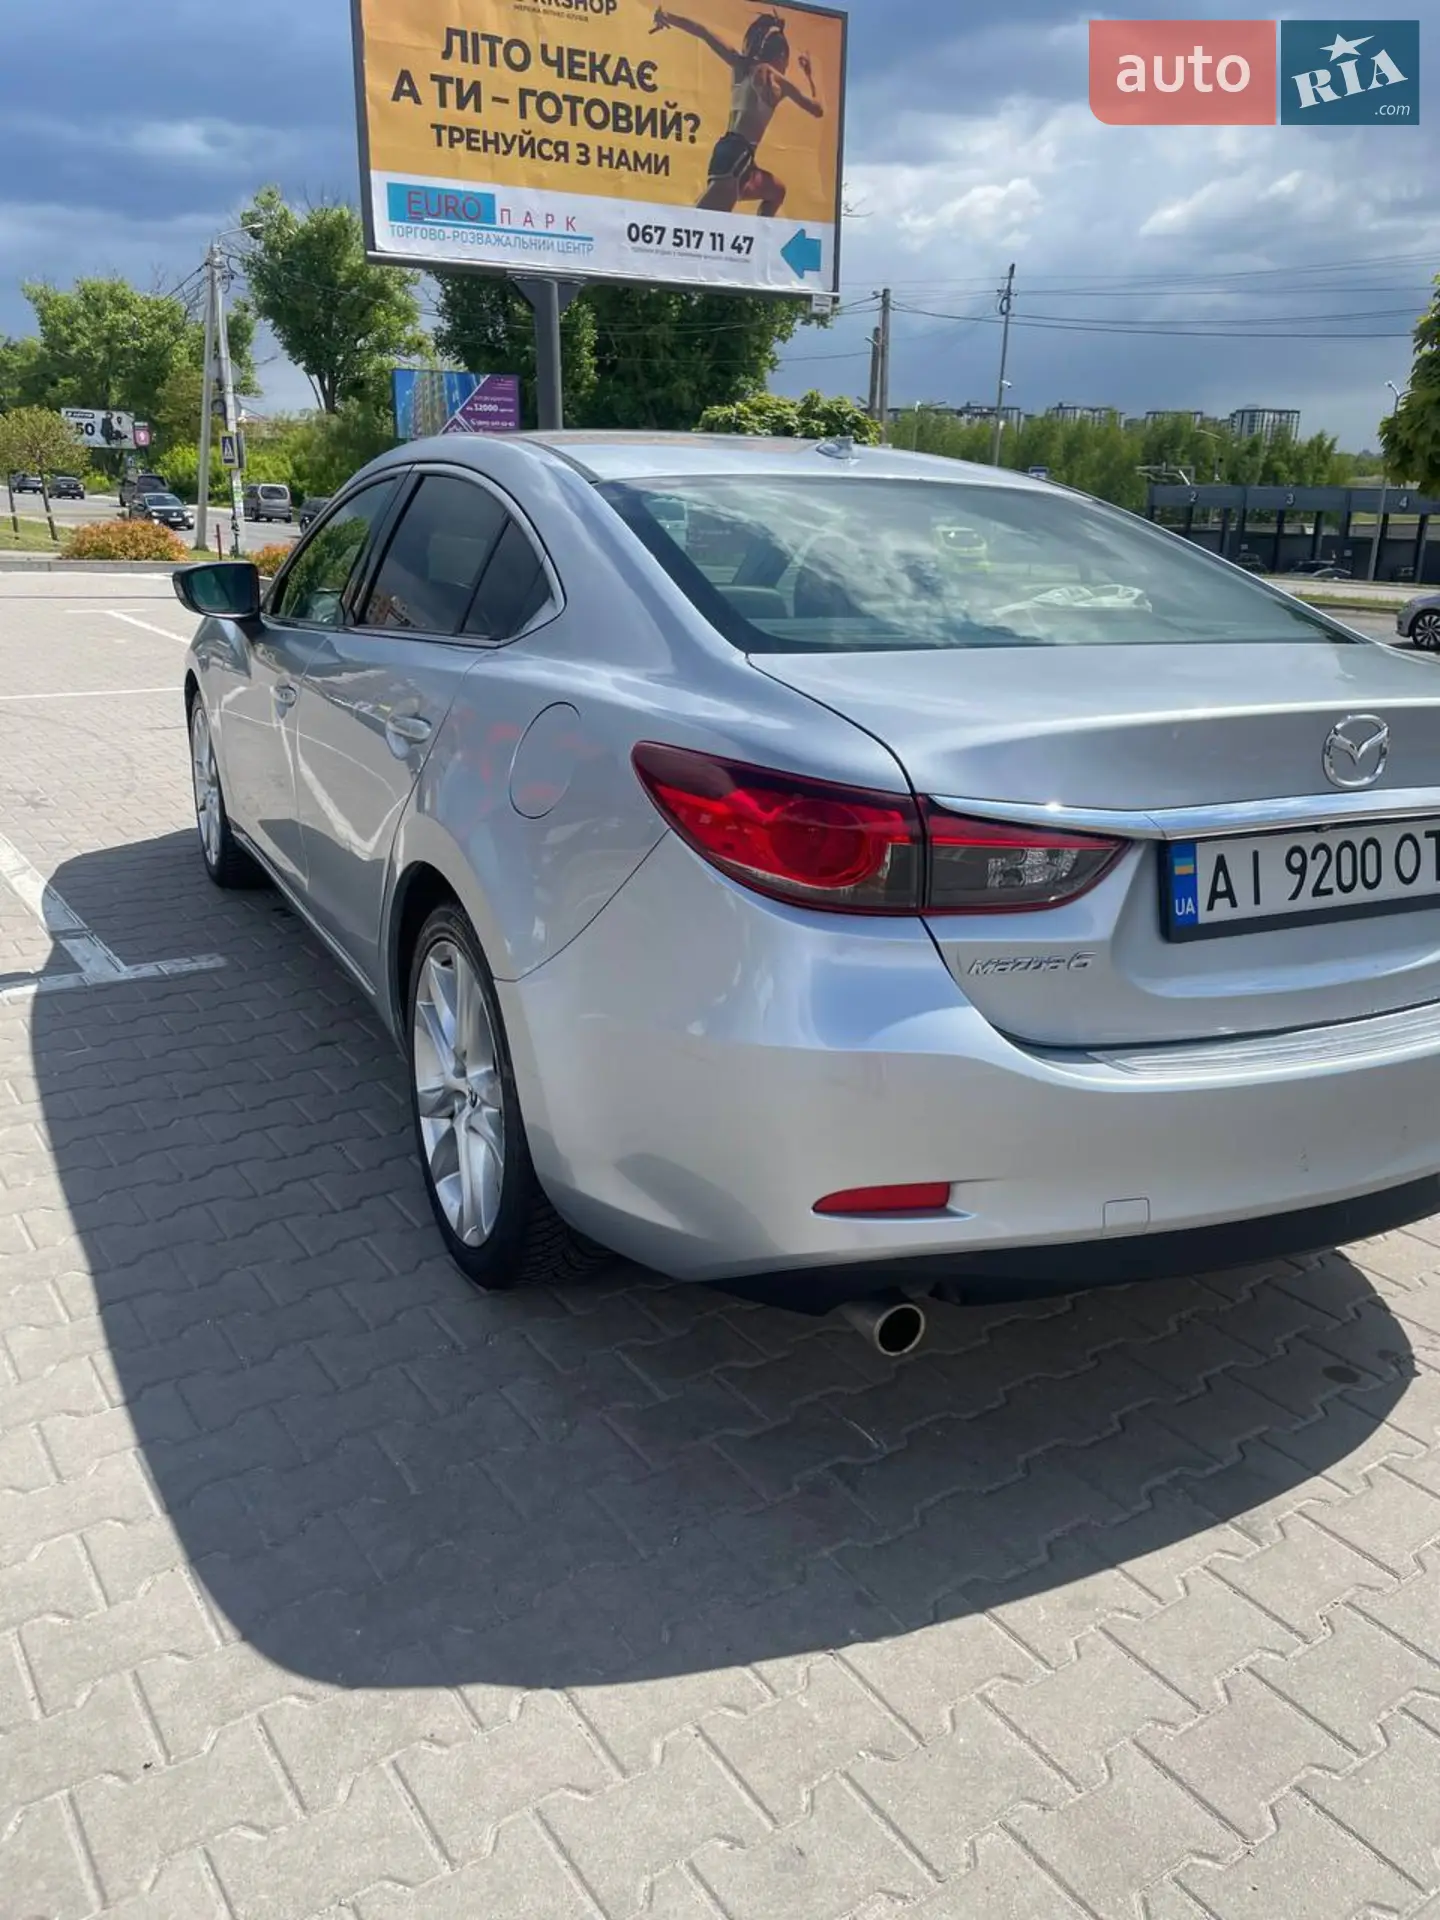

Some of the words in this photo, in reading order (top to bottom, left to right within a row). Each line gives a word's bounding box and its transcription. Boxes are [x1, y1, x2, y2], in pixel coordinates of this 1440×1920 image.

[441, 27, 531, 72] ЛІТО
[540, 43, 659, 93] ЧЕКАЄ
[391, 69, 422, 105] А
[430, 73, 482, 113] ТИ
[518, 87, 701, 144] ГОТОВИЙ?
[430, 123, 570, 163] ТРЕНУЙСЯ
[597, 146, 670, 176] НАМИ
[408, 191, 482, 221] EURO
[500, 208, 576, 232] ПАРК
[557, 240, 594, 256] ЦЕНТР
[627, 222, 666, 245] 067
[672, 227, 704, 249] 517
[709, 232, 724, 252] 11
[730, 235, 754, 254] 47
[1286, 493, 1295, 505] 3
[1285, 837, 1382, 900] 9200
[1175, 898, 1196, 916] UA
